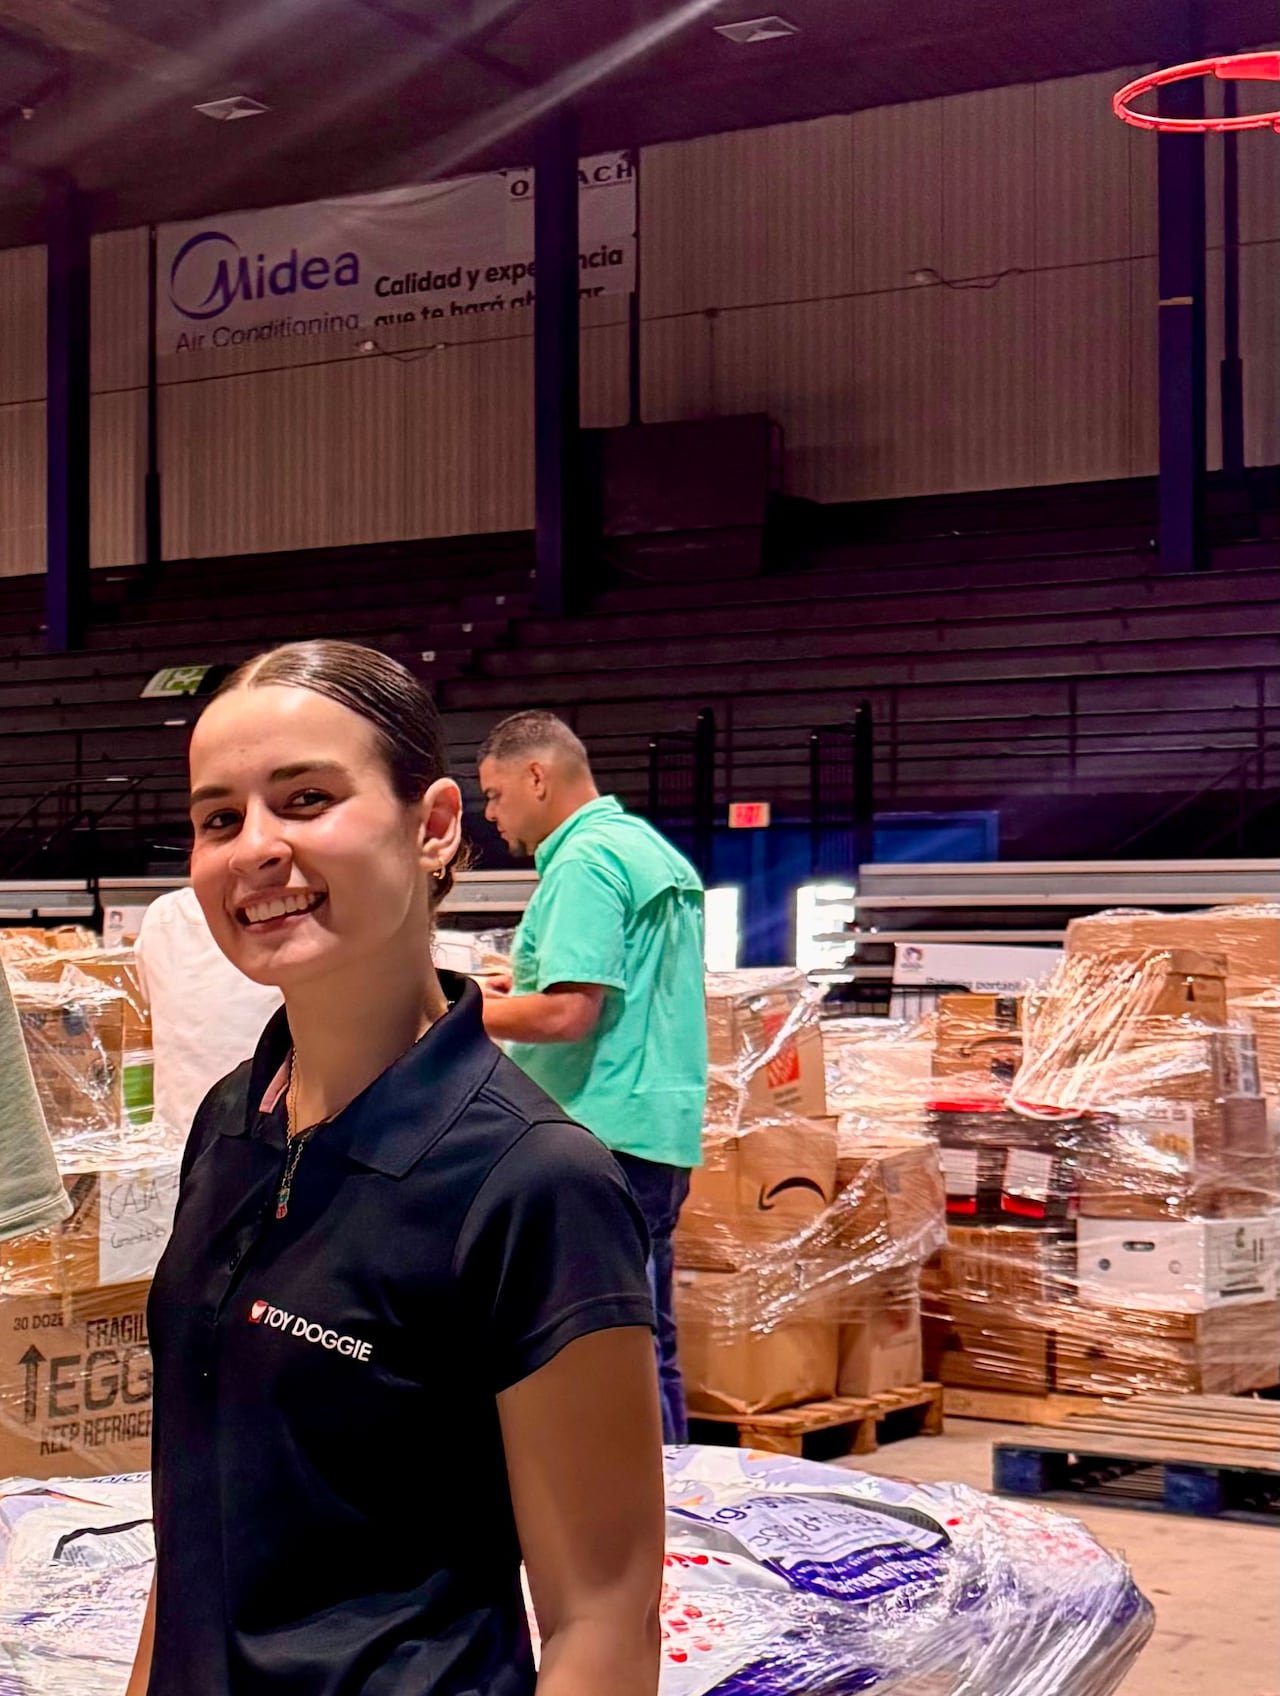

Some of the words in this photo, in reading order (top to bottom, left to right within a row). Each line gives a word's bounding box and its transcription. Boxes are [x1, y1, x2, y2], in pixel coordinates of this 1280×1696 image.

[170, 232, 360, 320] Midea
[375, 267, 461, 298] Calidad
[467, 270, 480, 291] y
[485, 245, 623, 284] expencia
[176, 333, 205, 353] Air
[13, 1317, 29, 1331] 30
[32, 1311, 64, 1330] DOZE
[86, 1313, 148, 1349] FRAGIL
[264, 1305, 295, 1331] TOY
[291, 1317, 373, 1362] DOGGIE
[48, 1343, 153, 1418] EGG
